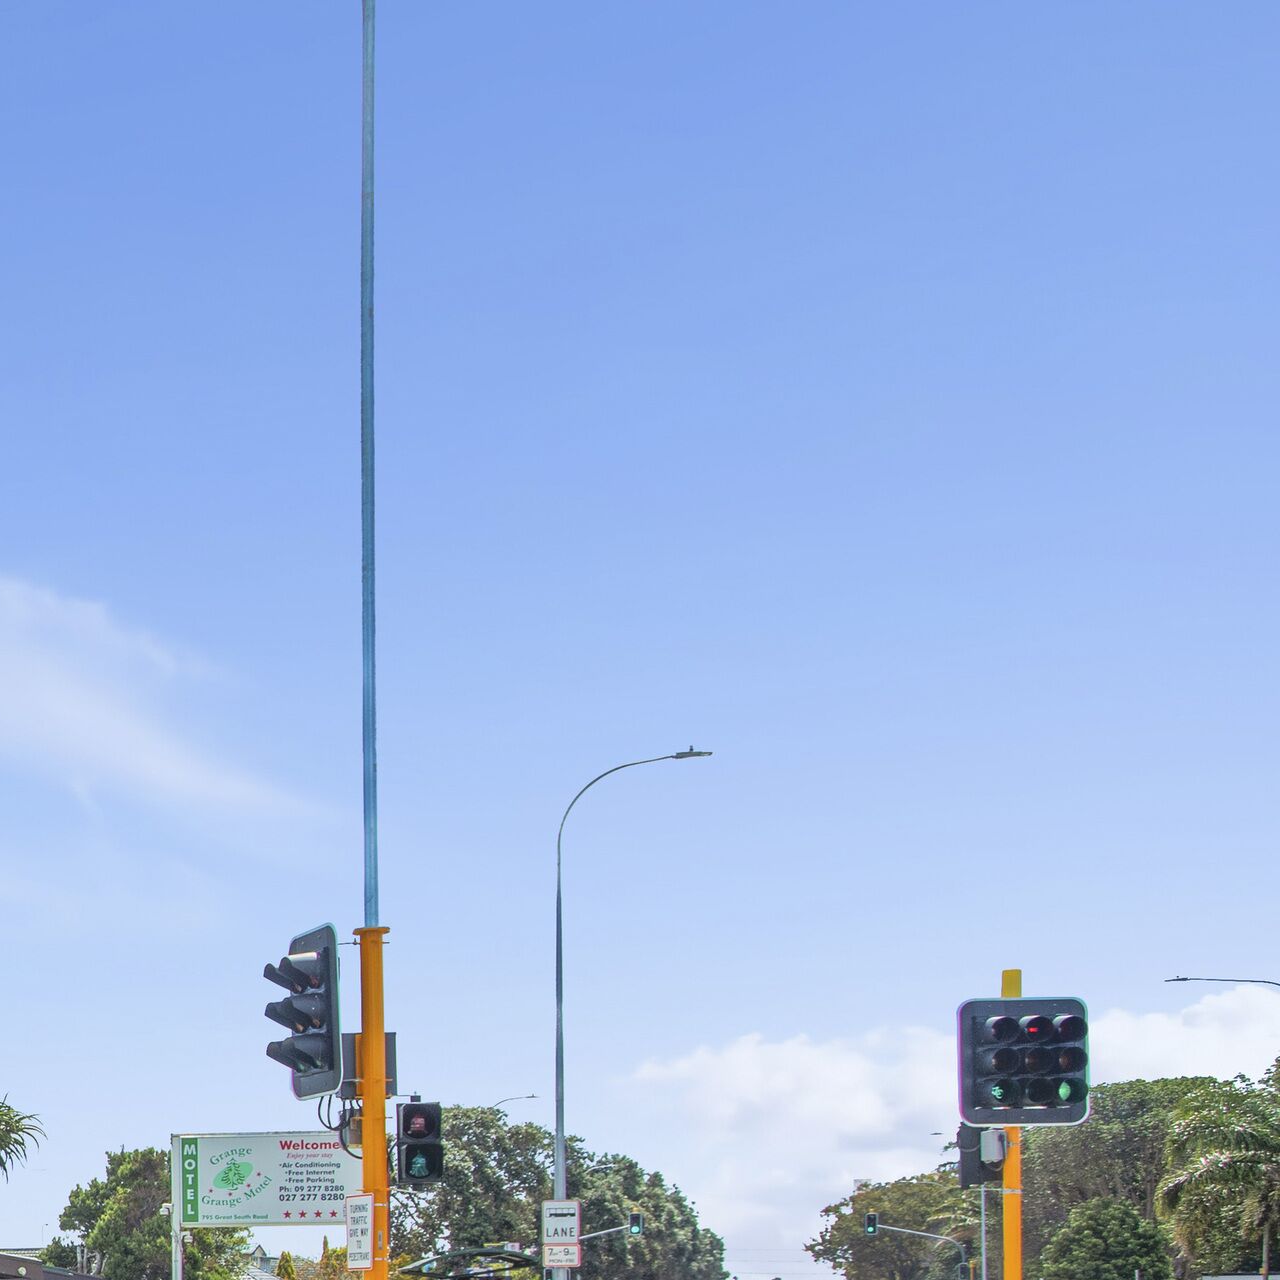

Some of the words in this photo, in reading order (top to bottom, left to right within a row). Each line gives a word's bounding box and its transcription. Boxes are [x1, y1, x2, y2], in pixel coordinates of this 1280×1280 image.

[279, 1139, 340, 1150] Welcome
[209, 1147, 252, 1165] Grange
[183, 1144, 197, 1215] MOTEL
[202, 1195, 241, 1208] Grange
[244, 1176, 272, 1200] Motel
[321, 1193, 345, 1201] 8280
[546, 1227, 576, 1237] LANE
